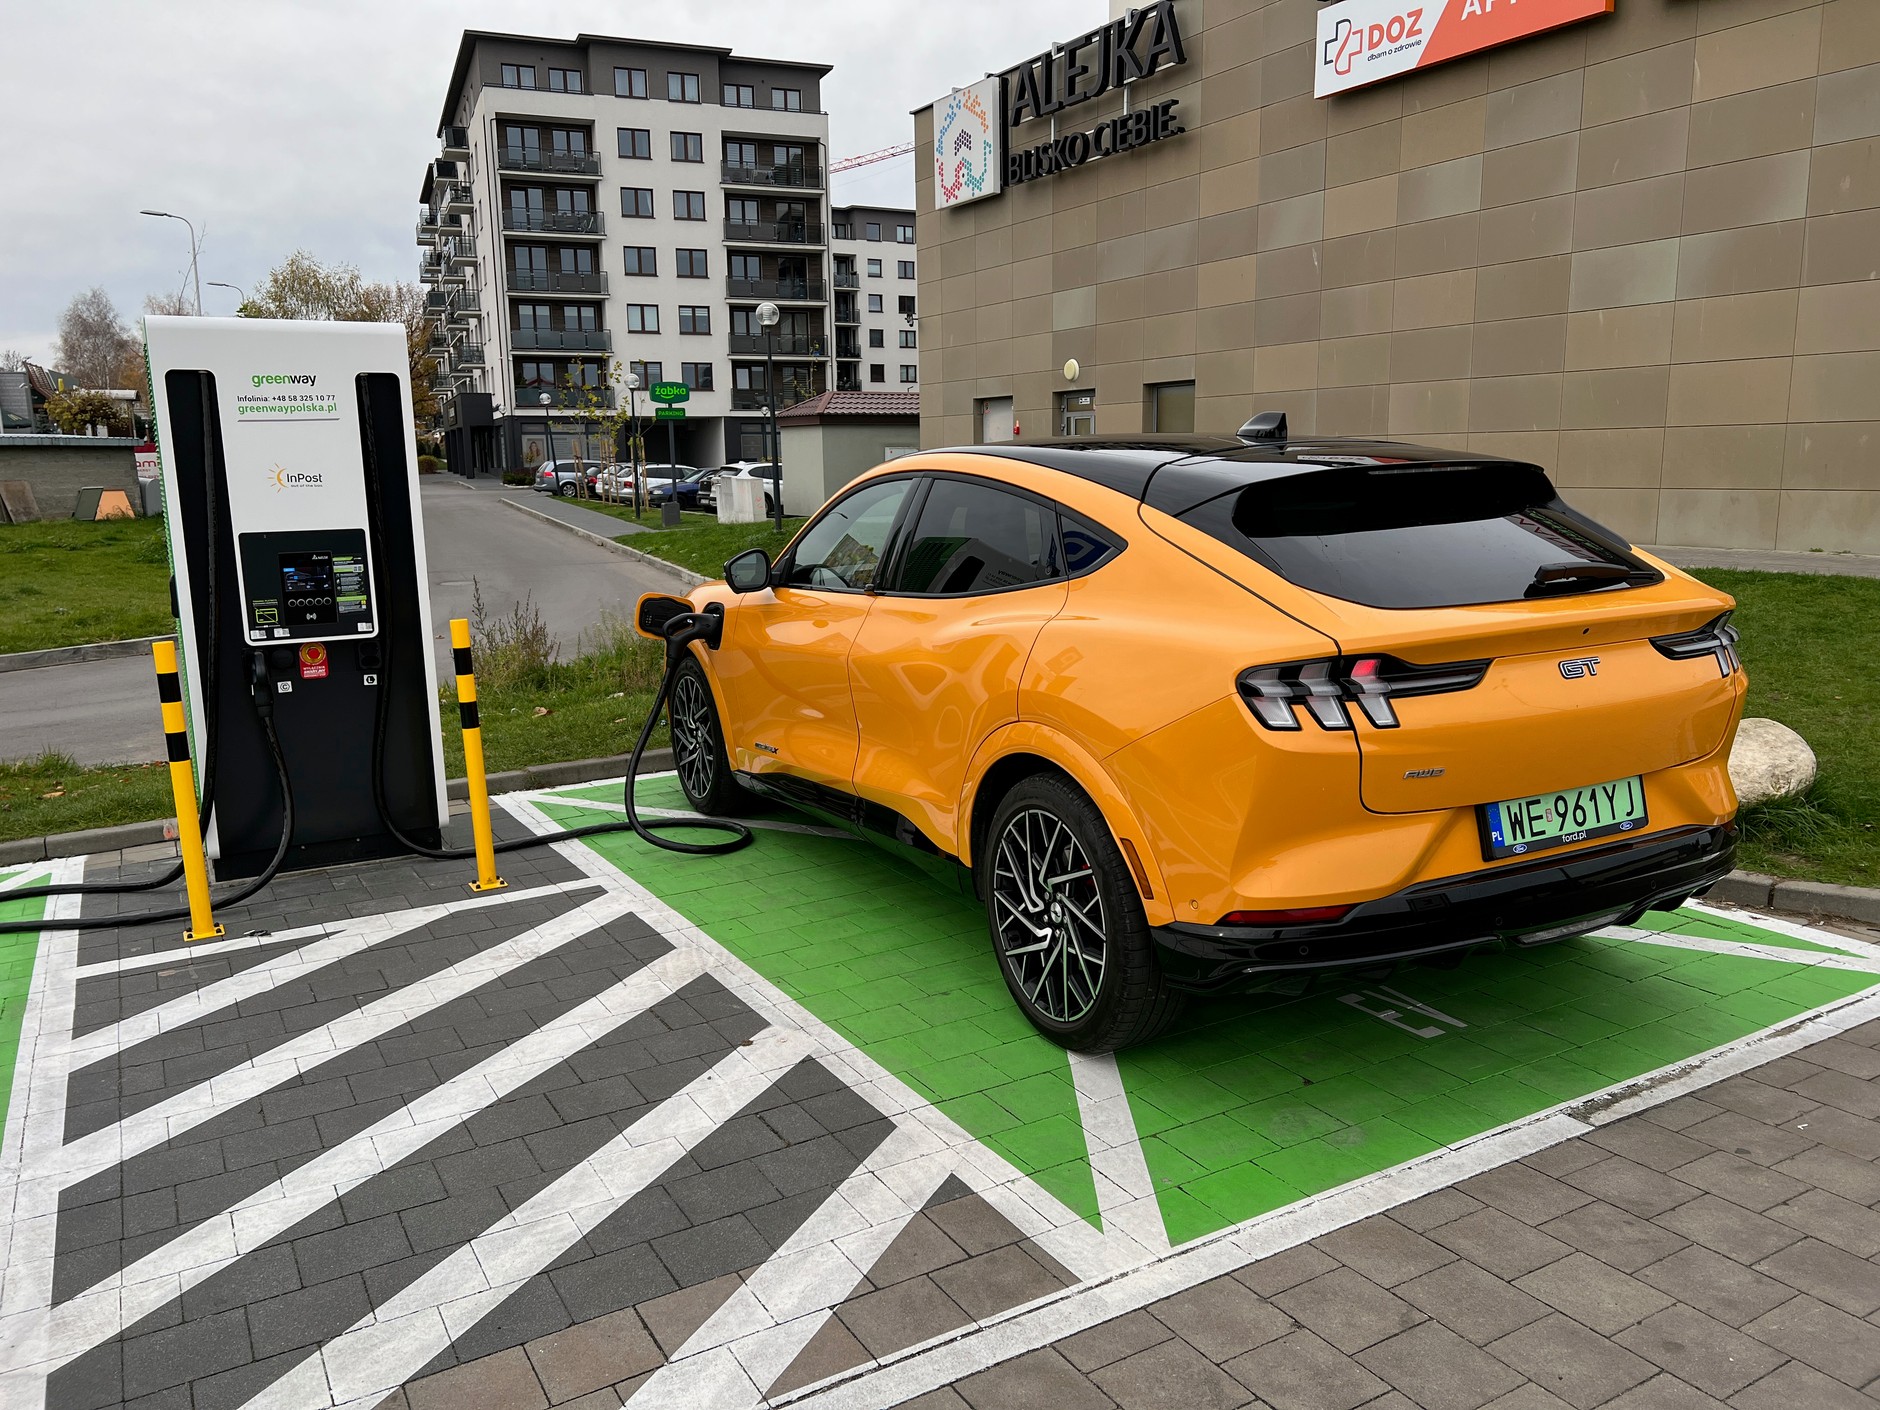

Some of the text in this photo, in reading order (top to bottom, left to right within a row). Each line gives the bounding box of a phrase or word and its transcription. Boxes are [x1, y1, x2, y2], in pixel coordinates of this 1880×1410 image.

[1368, 8, 1423, 50] DOZ
[1367, 51, 1387, 62] dbam
[1393, 39, 1422, 53] zdrowie
[1010, 0, 1187, 127] ALEJKA
[1009, 131, 1090, 185] BLISKO
[252, 375, 316, 387] greenway
[655, 386, 686, 395] żabka
[299, 394, 314, 402] 325
[315, 394, 325, 402] 10
[238, 403, 337, 414] greenwaypolska.pl
[286, 473, 323, 483] InPost
[1558, 657, 1600, 679] GT
[1403, 768, 1446, 780] AWD
[1506, 781, 1635, 841] WE 961YJ
[1492, 831, 1502, 842] PL
[1562, 830, 1587, 843] ford.pl
